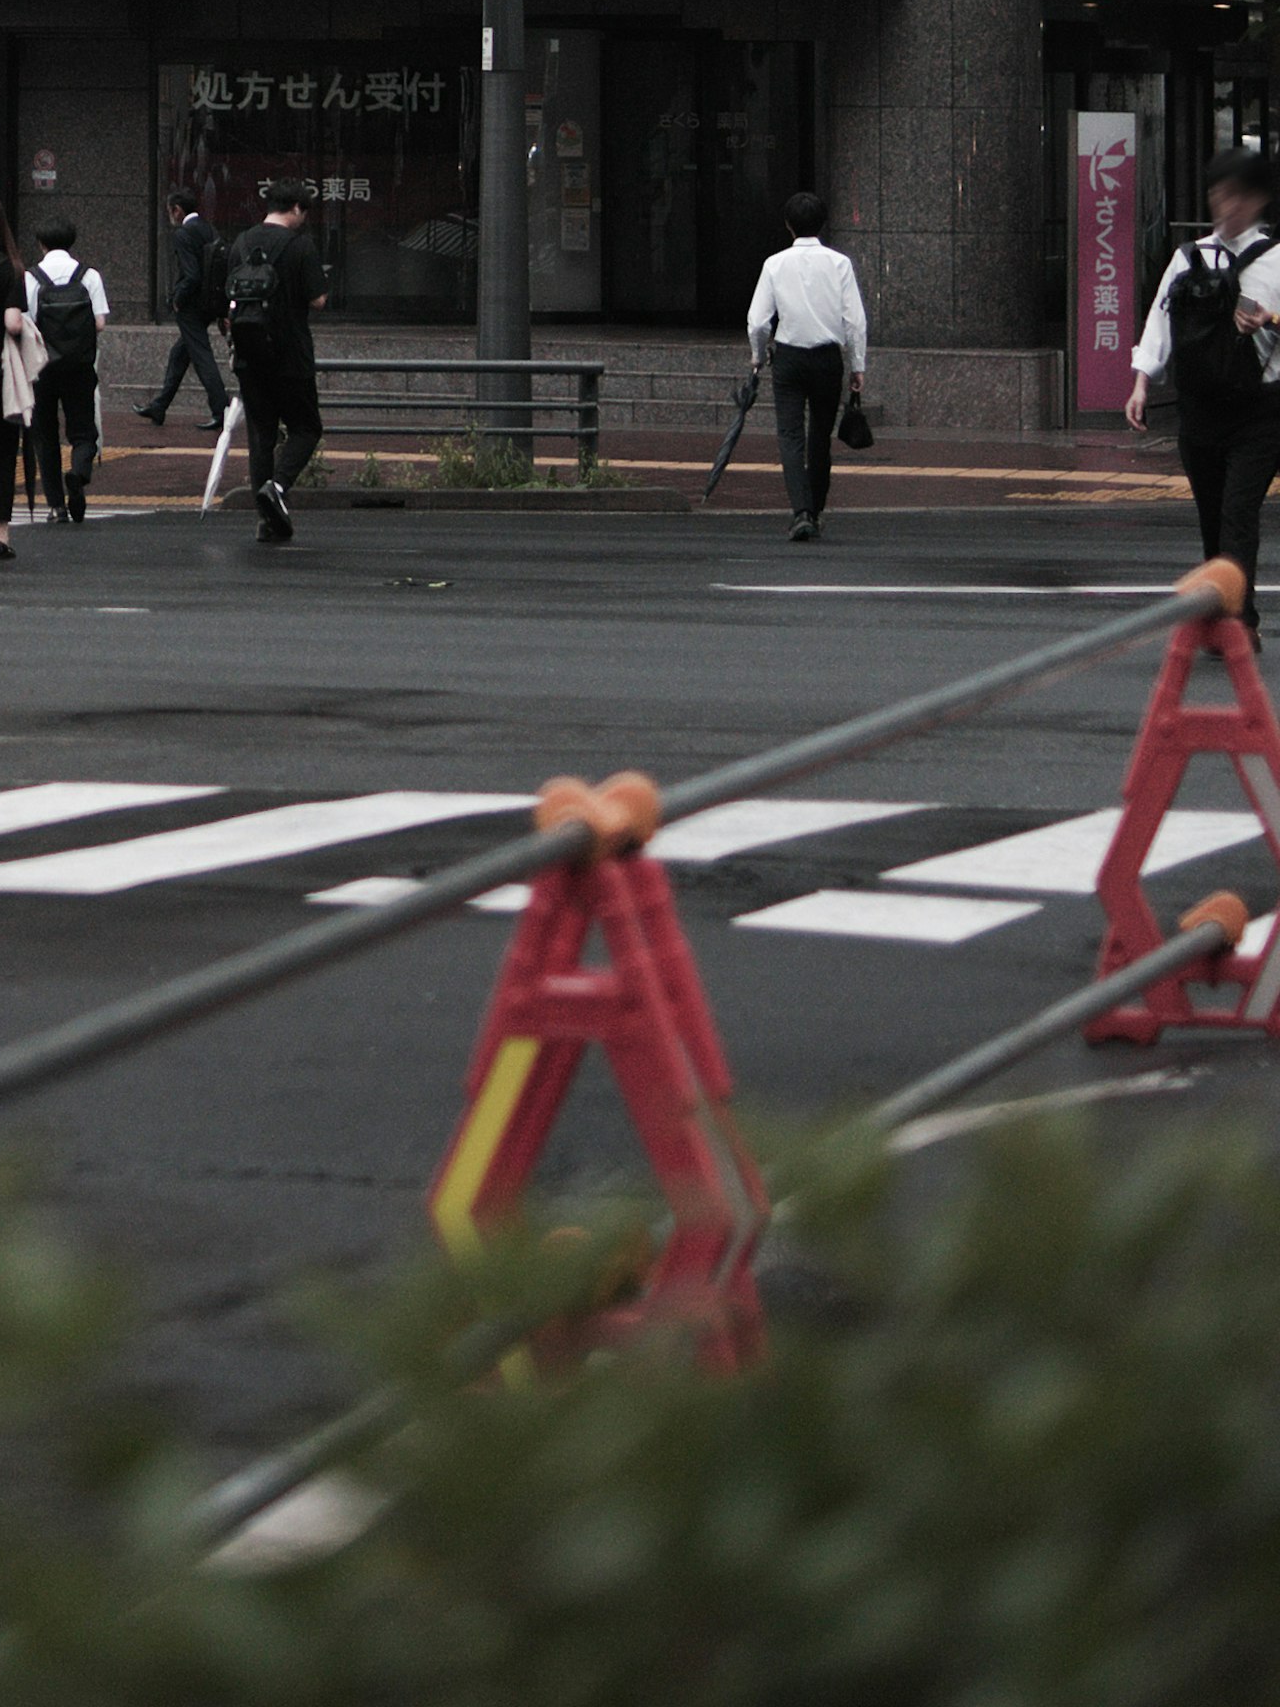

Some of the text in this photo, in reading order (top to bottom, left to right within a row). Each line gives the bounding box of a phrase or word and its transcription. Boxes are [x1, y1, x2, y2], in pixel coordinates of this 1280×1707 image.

[191, 71, 446, 113] 処方せん受付
[257, 177, 371, 202] さら薬局
[1093, 195, 1120, 352] さくら薬局
